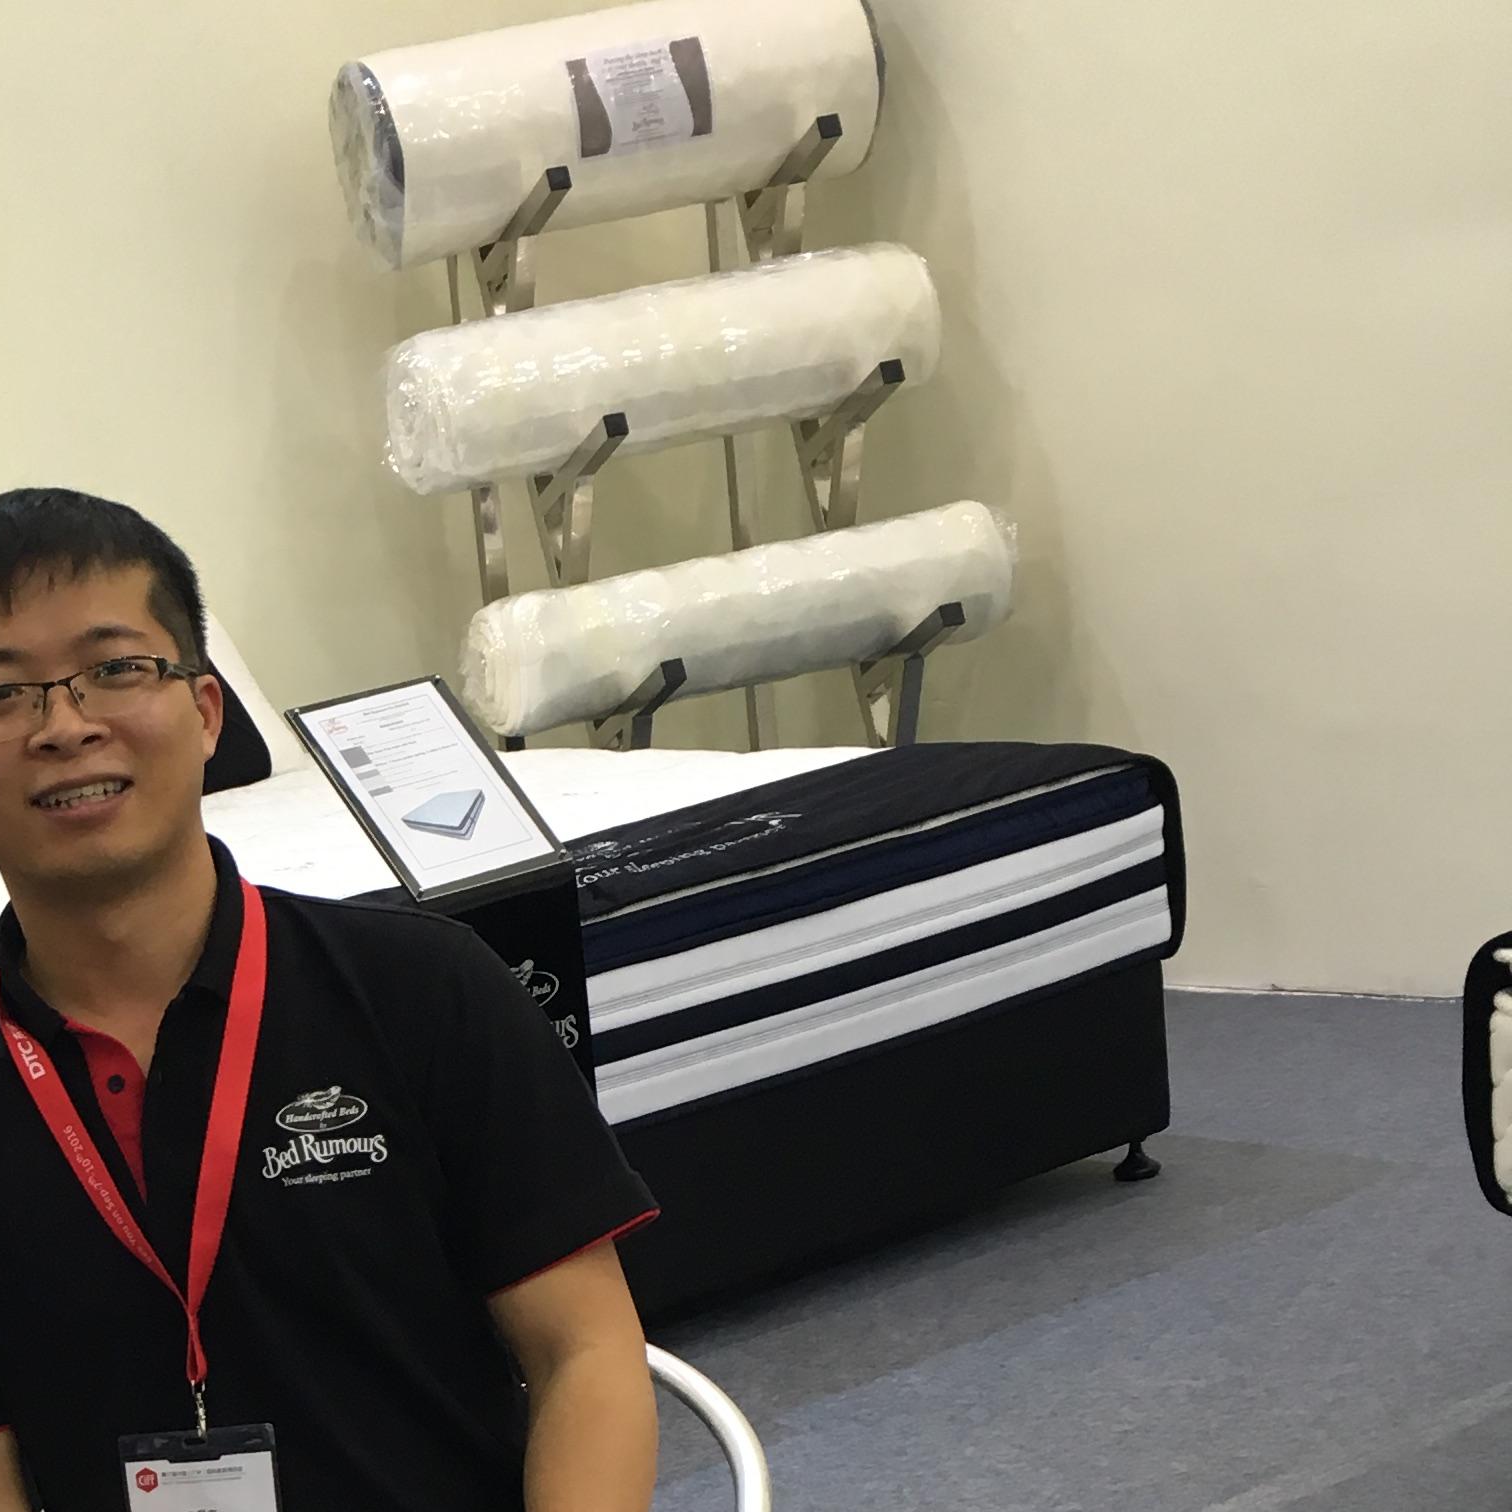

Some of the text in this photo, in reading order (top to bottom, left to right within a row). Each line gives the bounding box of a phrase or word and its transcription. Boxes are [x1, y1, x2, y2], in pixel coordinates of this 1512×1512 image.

[17, 1040, 47, 1080] DTC
[63, 1124, 85, 1151] 2016
[262, 1133, 388, 1179] Bed Rumours
[281, 1177, 304, 1187] Your
[340, 1167, 372, 1181] partner
